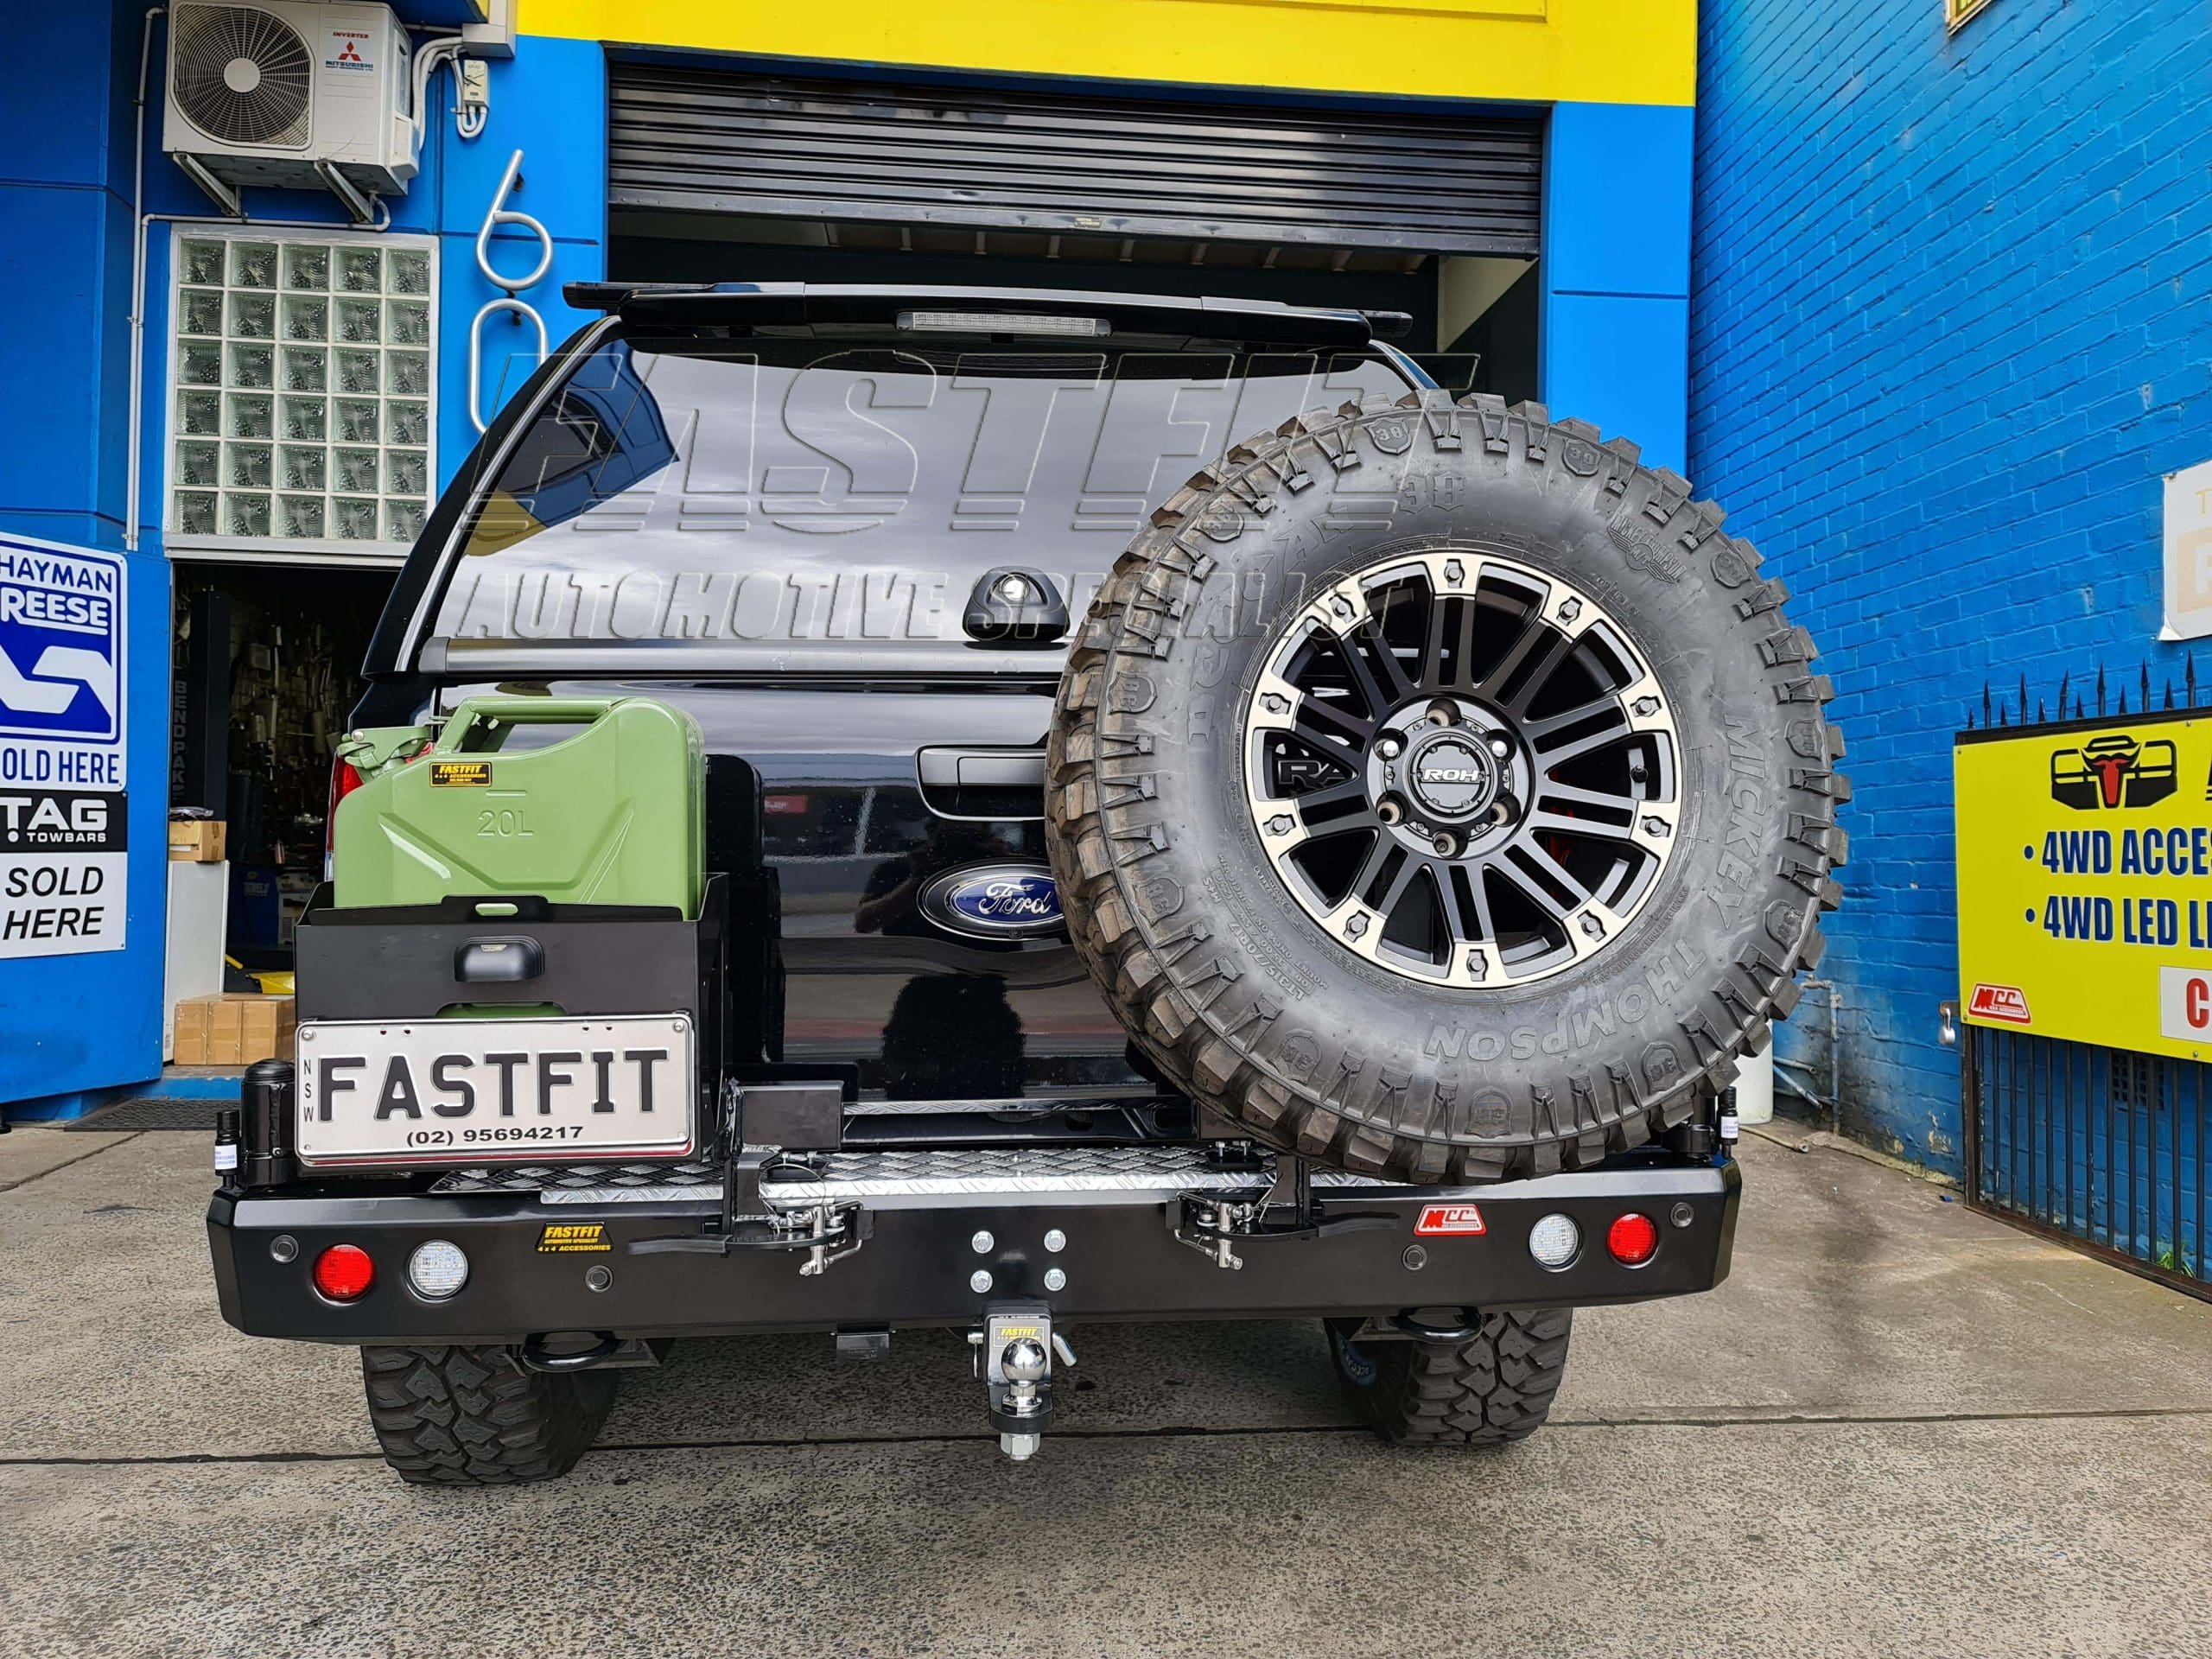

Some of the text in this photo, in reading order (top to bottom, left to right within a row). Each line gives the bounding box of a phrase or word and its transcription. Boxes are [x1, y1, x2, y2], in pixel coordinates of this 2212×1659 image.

[325, 60, 373, 69] MITSUBISHI
[0, 555, 111, 594] HAYMAN
[1, 587, 109, 635] REESE
[173, 681, 188, 785] BENDPAK
[59, 751, 120, 785] HERE
[439, 765, 482, 774] FASTFIT
[1424, 769, 1479, 782] ROH
[0, 797, 108, 836] TAG
[477, 810, 534, 837] 20L
[27, 832, 107, 842] TOWBARS
[2042, 827, 2212, 876] 4WD ACCE
[5, 867, 104, 898] SOLD
[978, 883, 1052, 914] Ford
[1203, 877, 1222, 903] M+S
[1424, 714, 1766, 1061] MICKEY THOMPSON
[3, 906, 105, 940] HERE
[2044, 895, 2113, 942] 4WD
[2123, 898, 2178, 946] LED
[1228, 922, 1306, 1001] LT315/70R17
[1974, 988, 2023, 1010] MCC
[2186, 978, 2209, 1028] C
[302, 1058, 315, 1122] NSW
[317, 1049, 669, 1122] FASTFIT
[406, 1126, 584, 1147] (02) 95694217
[544, 1226, 603, 1238] FASTFIT
[1422, 1210, 1478, 1228] MCC
[1001, 1327, 1037, 1337] FASTFIT
